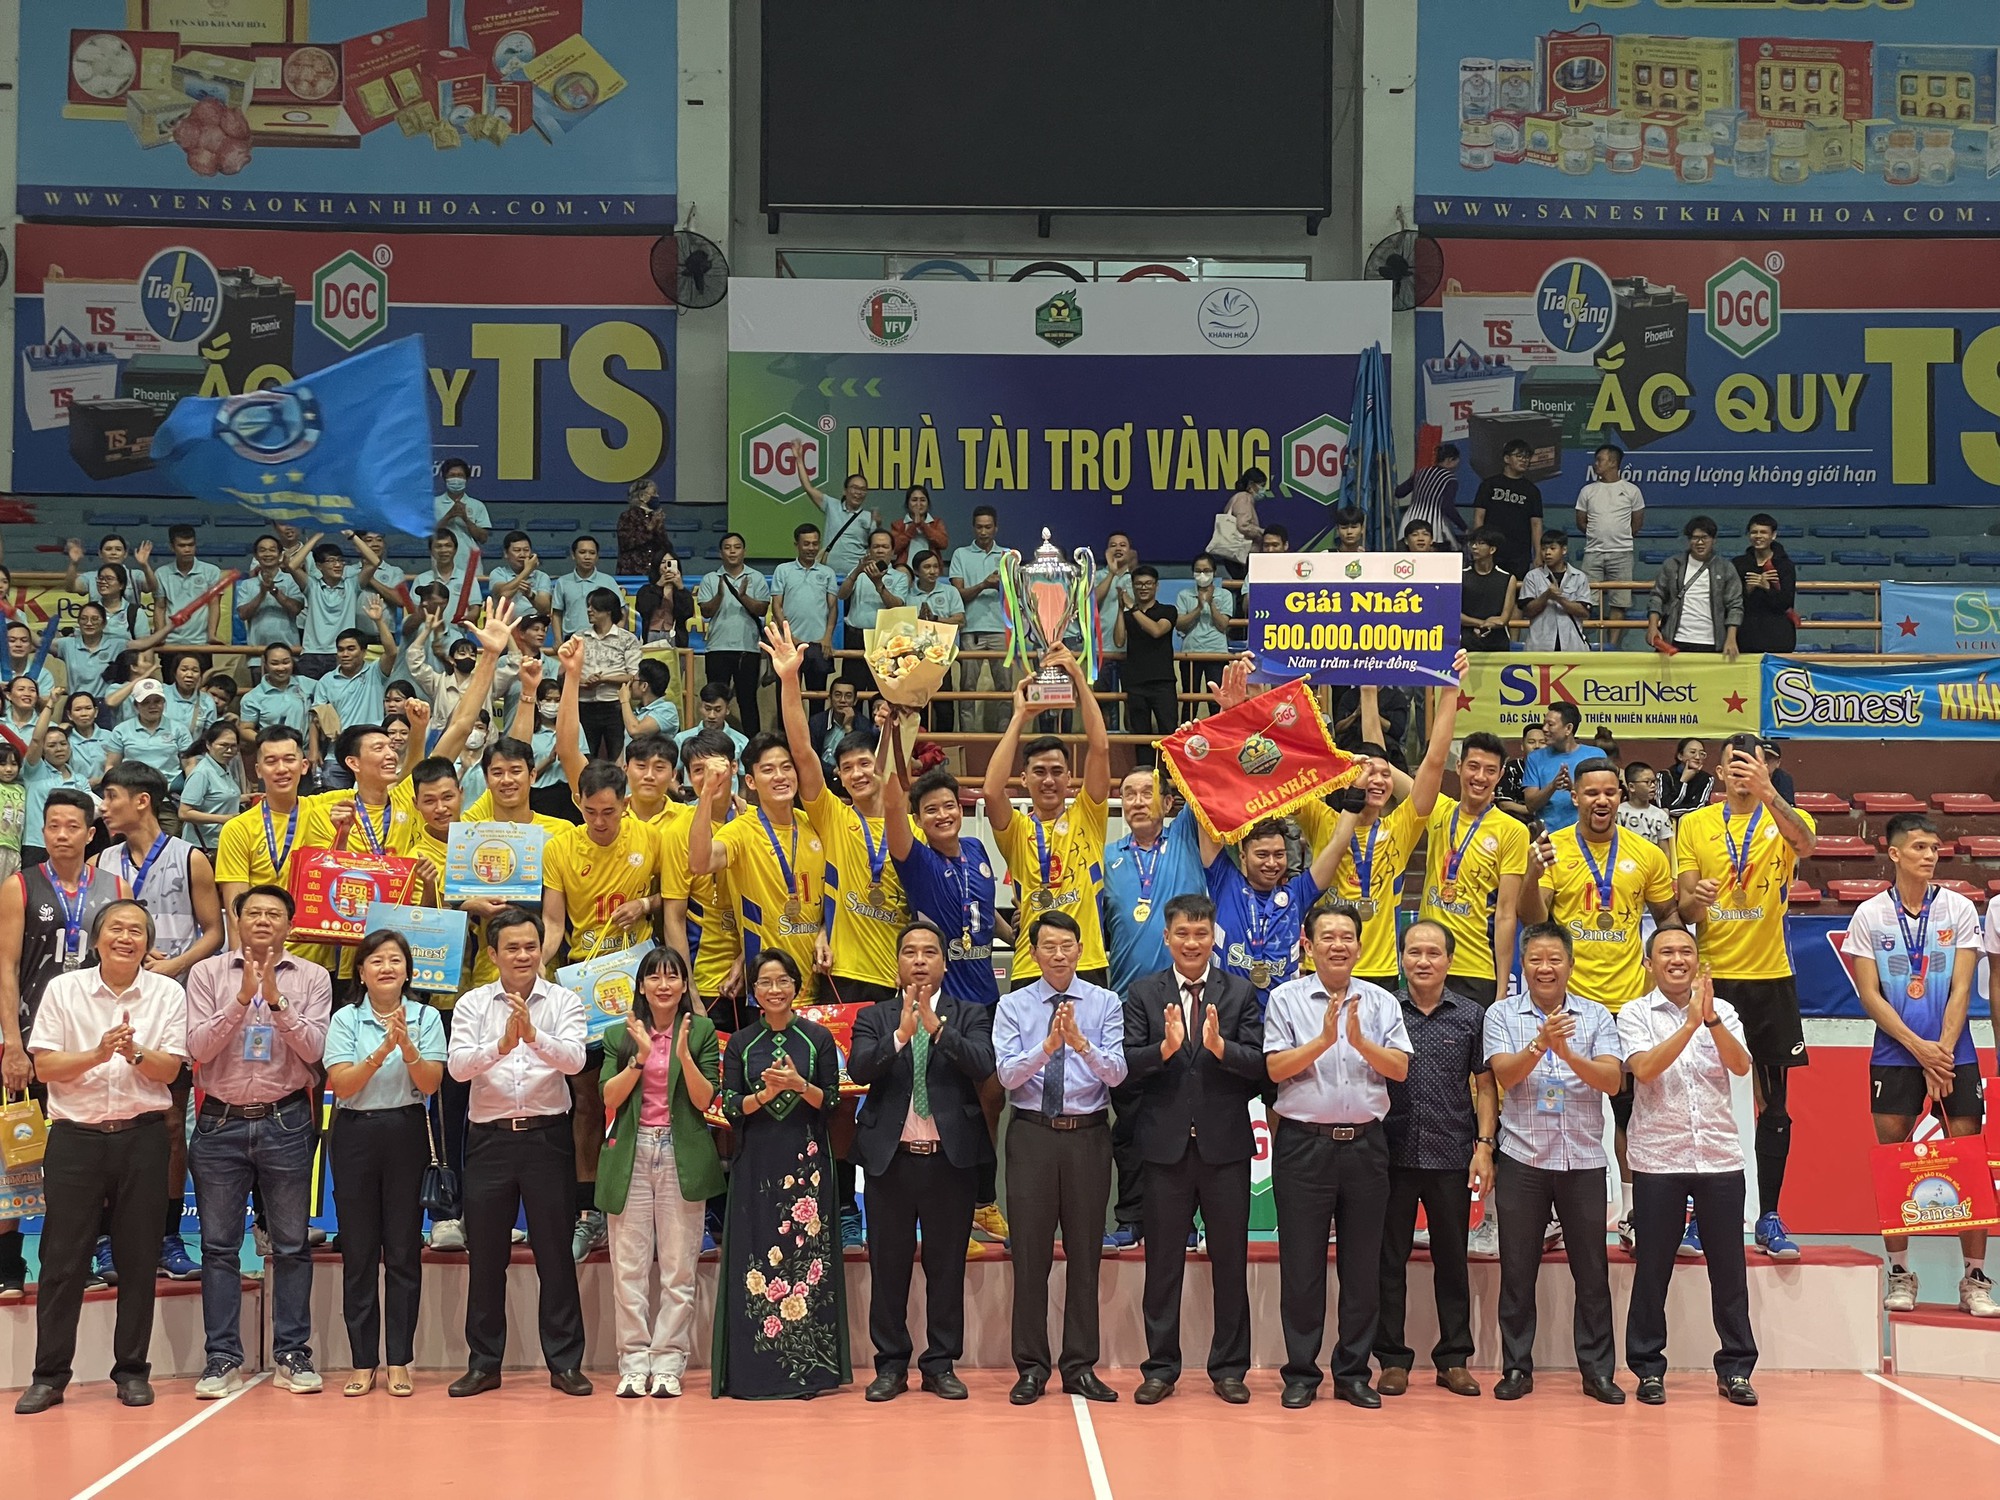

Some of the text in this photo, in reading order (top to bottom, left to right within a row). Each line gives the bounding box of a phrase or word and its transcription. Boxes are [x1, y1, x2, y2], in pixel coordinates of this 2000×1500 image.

[44, 190, 639, 216] WWW.YENSAOKHANHHOA.COM.VN
[147, 275, 215, 323] Tia Sáng
[324, 282, 378, 320] DGC
[1542, 287, 1609, 333] Tia Sáng
[1717, 290, 1769, 327] DGC
[86, 307, 116, 334] TS
[251, 320, 281, 334] Phoenix
[884, 321, 906, 333] VFV
[1208, 331, 1233, 339] KHÁNH
[1483, 319, 1513, 347] TS
[1644, 327, 1674, 344] Phoenix
[50, 387, 74, 408] TS
[133, 387, 176, 401] Phoenix
[1586, 340, 1691, 433] ẮC
[1714, 373, 1864, 433] QUY
[471, 321, 663, 482] TS
[1450, 400, 1474, 420] TS
[1530, 399, 1573, 412] Phoenix
[105, 429, 127, 450] TS
[753, 442, 817, 476] DGC
[847, 413, 1270, 505] NHÀ TÀI TRỢ VÀNG
[1646, 465, 1691, 486] năng
[1695, 465, 1744, 487] lượng
[1748, 464, 1803, 486] không
[1807, 464, 1839, 487] giới
[1843, 464, 1877, 487] hạn
[1492, 488, 1527, 505] Dior
[1396, 565, 1412, 574] DGC
[1284, 588, 1424, 613] Giải Nhất
[1263, 624, 1444, 651] 500.000.000vnđ
[1287, 655, 1418, 672] Năm trăm triệu đồng
[1499, 663, 1699, 707] SK PearlNest
[1774, 669, 1925, 725] Sanest
[1276, 707, 1297, 723] DGC
[1500, 712, 1519, 725] ĐẶC
[1521, 710, 1540, 724] SẢN
[1585, 712, 1612, 724] THIÊN
[1614, 712, 1643, 724] NHIÊN
[1645, 712, 1677, 724] KHÁNH
[1679, 712, 1699, 724] HÒA
[1245, 768, 1321, 814] GIẢI NHẤT
[845, 891, 899, 924] Sanest
[1708, 902, 1764, 922] Sanest
[778, 914, 820, 936] Sanes
[1569, 920, 1627, 943] Sanest
[1874, 1080, 1883, 1098] 7
[1901, 1200, 1971, 1225] Sanest
